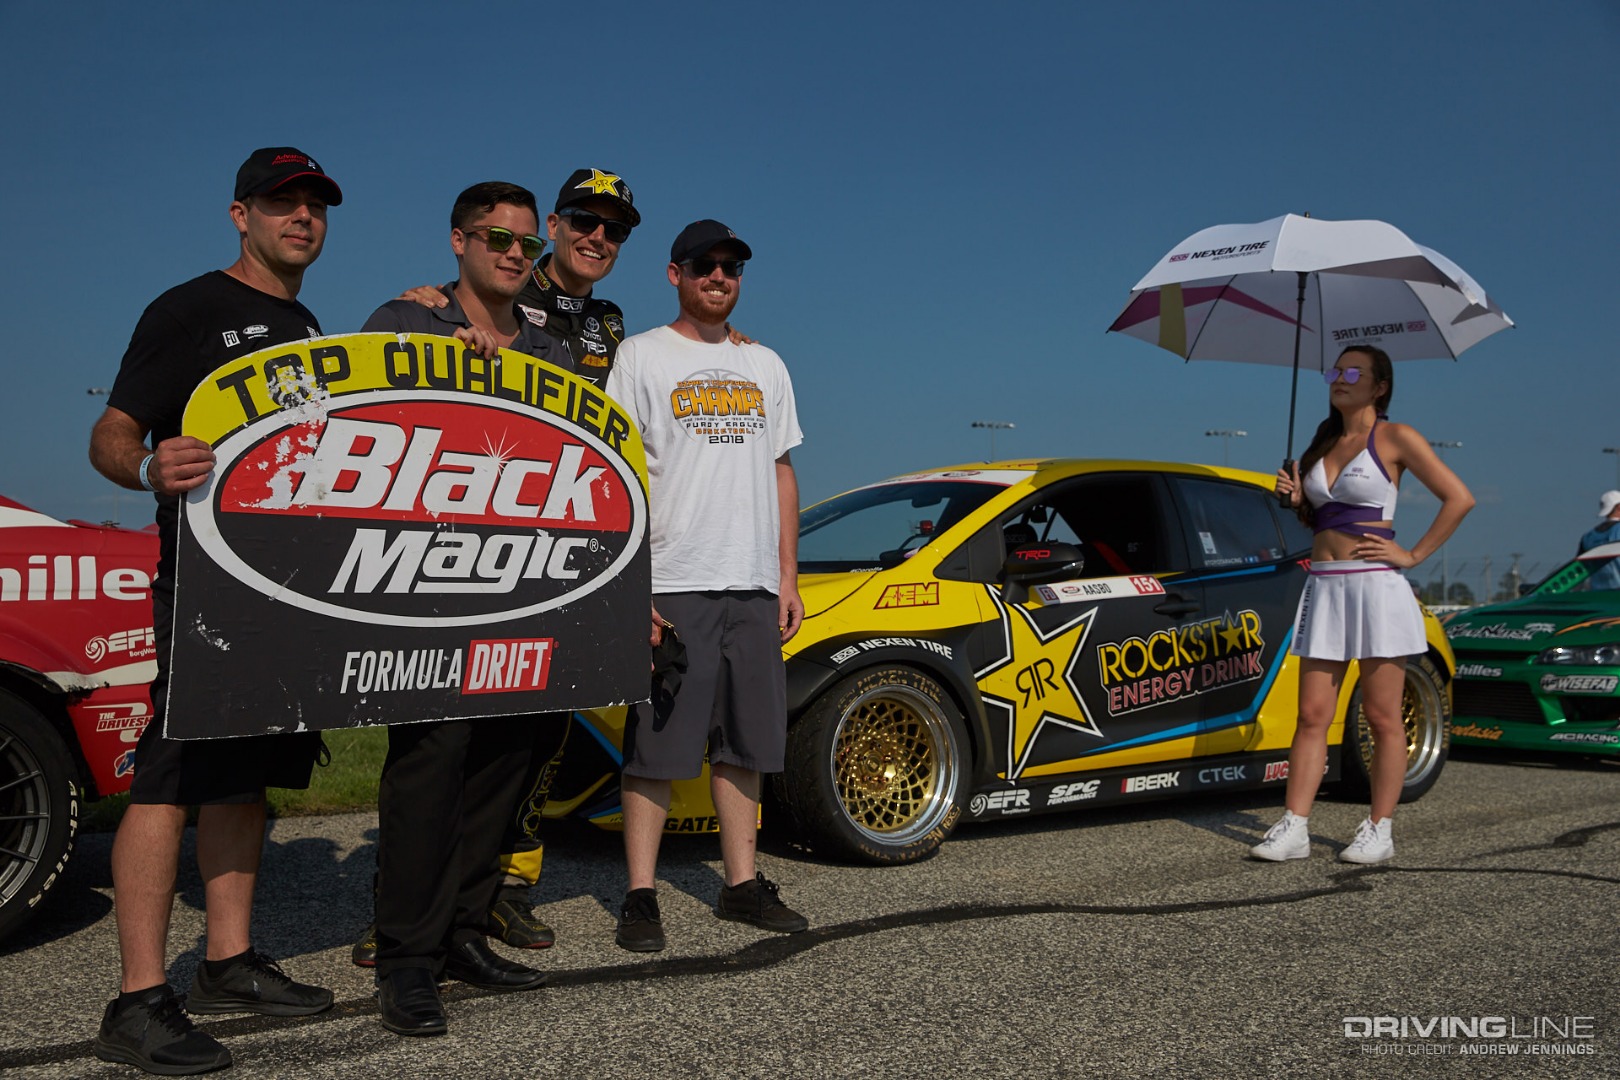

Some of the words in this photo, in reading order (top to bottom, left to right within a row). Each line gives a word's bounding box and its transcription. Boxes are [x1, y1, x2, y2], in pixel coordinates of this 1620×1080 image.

[1191, 246, 1237, 260] NEXEN
[1239, 240, 1270, 252] TIRE
[583, 329, 602, 342] TOYOTA
[216, 344, 351, 420] TOP
[383, 341, 630, 452] QUALIFIER
[670, 386, 765, 420] CHAMPS
[725, 421, 764, 429] EAGLES
[709, 435, 744, 444] 2018
[289, 414, 607, 523] Black
[328, 527, 590, 595] Magic
[1015, 549, 1051, 560] TRD
[873, 582, 939, 610] AEM
[1082, 583, 1112, 596] AASBO
[1132, 576, 1163, 593] 151
[858, 637, 917, 651] NEXEN
[916, 638, 953, 661] TIRE
[339, 648, 463, 694] FORMULA
[467, 641, 550, 690] DRIFT
[1109, 666, 1196, 711] ENERGY
[1201, 650, 1262, 687] DRINK
[1557, 678, 1618, 690] WISEFAB
[97, 715, 153, 731] DRIVESH
[99, 712, 116, 720] THE
[1576, 733, 1619, 743] RACING
[1133, 770, 1181, 792] BERK
[1198, 765, 1247, 784] CTEK
[1263, 761, 1289, 782] LUC
[1046, 791, 1098, 806] PERFORMANCE
[1048, 779, 1102, 799] SPC
[987, 789, 1031, 810] EFR
[664, 816, 719, 832] GATE
